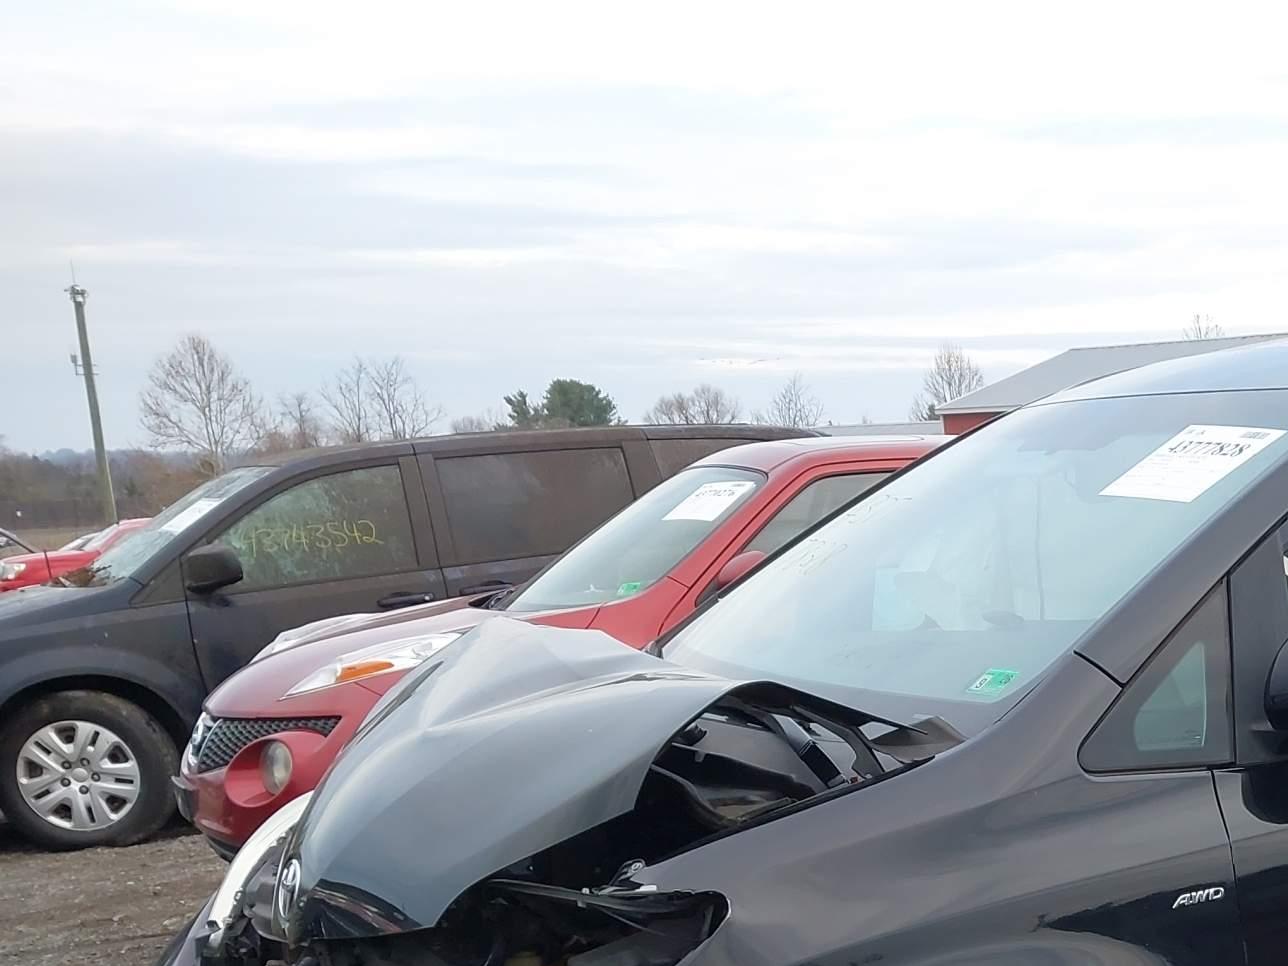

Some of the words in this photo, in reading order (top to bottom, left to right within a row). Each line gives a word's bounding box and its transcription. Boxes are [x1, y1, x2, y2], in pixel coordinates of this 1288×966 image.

[1168, 440, 1251, 457] 43777828
[240, 519, 385, 558] 43743542
[1172, 887, 1225, 909] AWD
